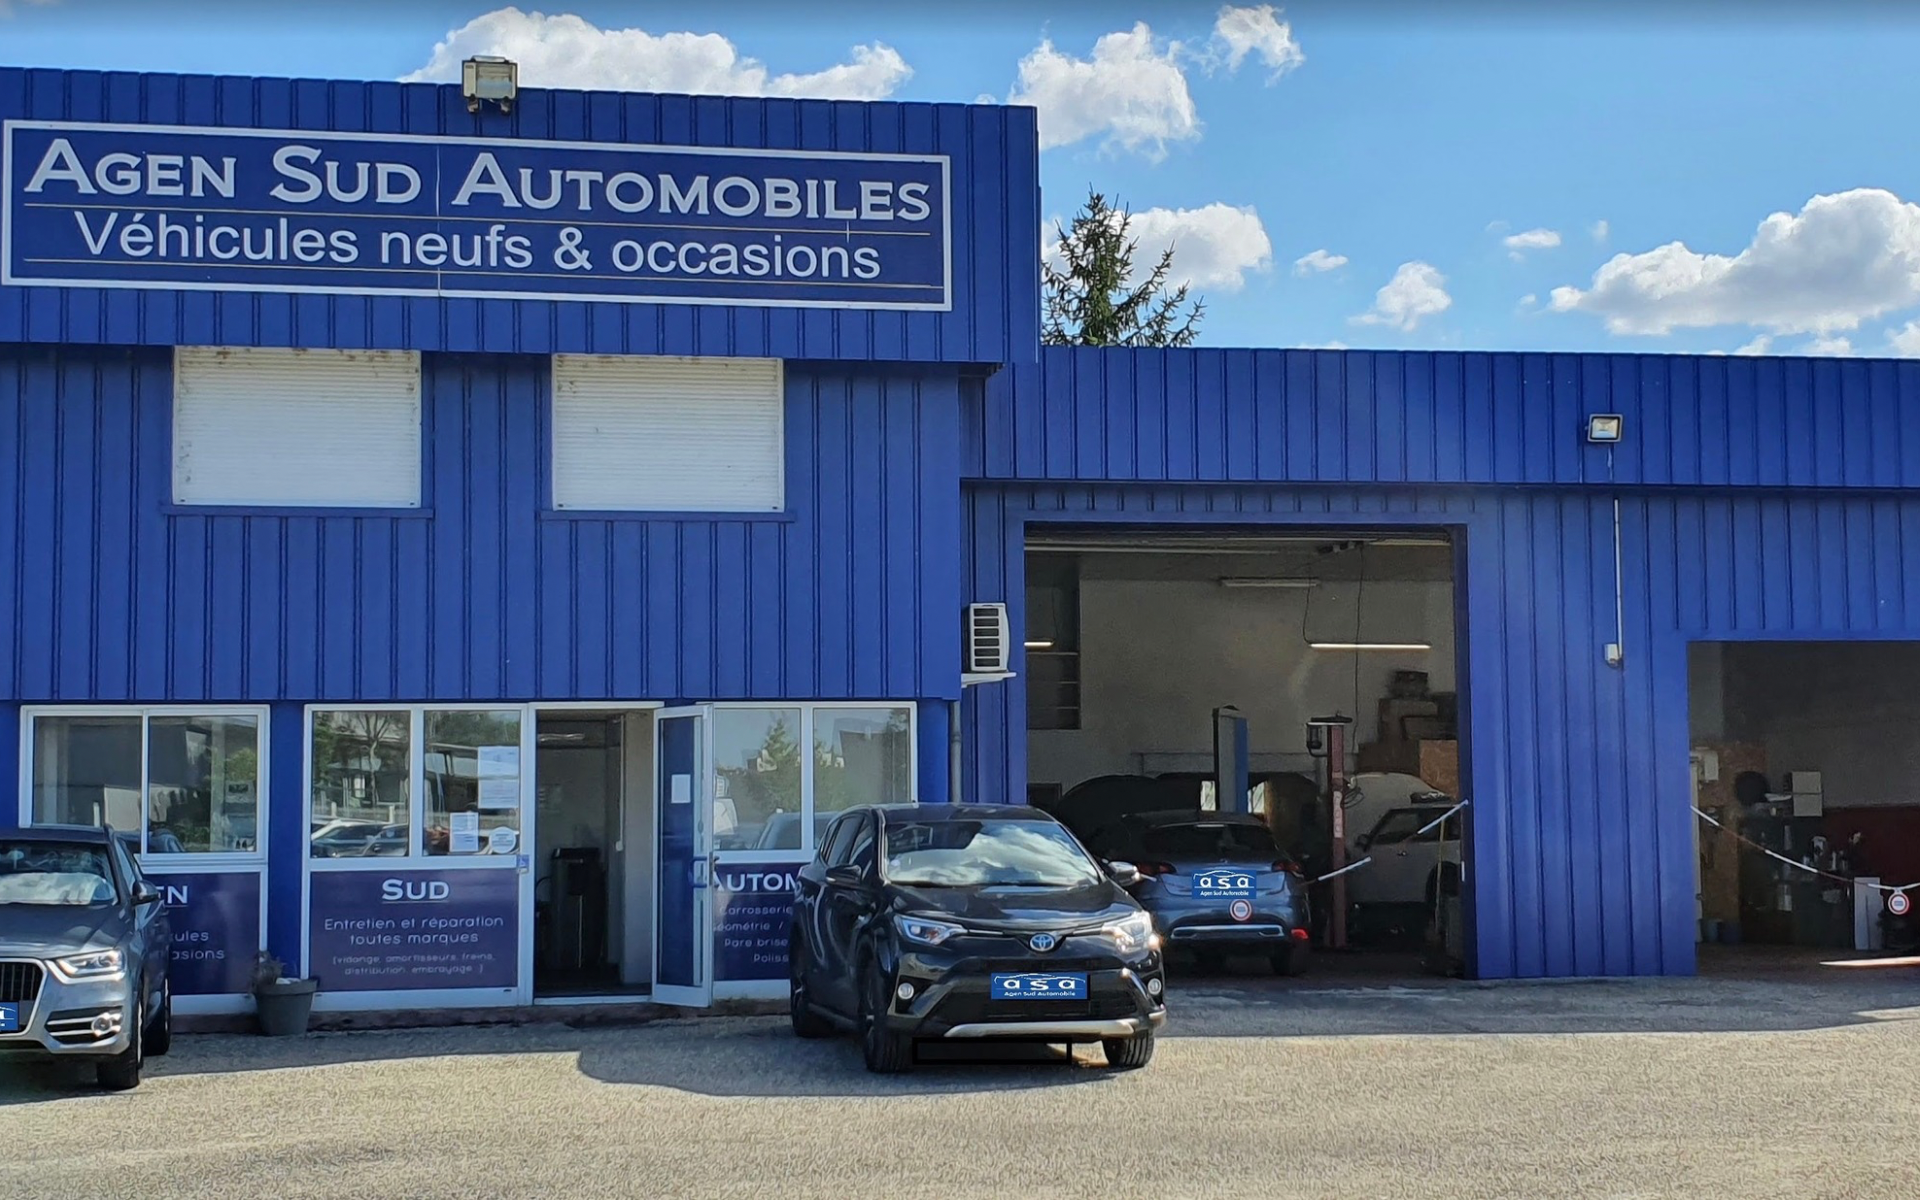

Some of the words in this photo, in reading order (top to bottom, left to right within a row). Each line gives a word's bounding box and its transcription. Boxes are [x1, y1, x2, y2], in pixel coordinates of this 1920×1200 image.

[24, 138, 237, 198] AGEN
[269, 145, 422, 203] SUD
[451, 152, 931, 221] AUTOMOBILES
[74, 210, 359, 263] Véhicules
[381, 224, 533, 268] neufs
[554, 226, 593, 271] &
[612, 235, 881, 279] occasions
[324, 918, 396, 931] Entretien
[401, 917, 415, 929] et
[421, 916, 504, 931] réparation
[350, 934, 401, 946] toutes
[407, 932, 479, 947] marques
